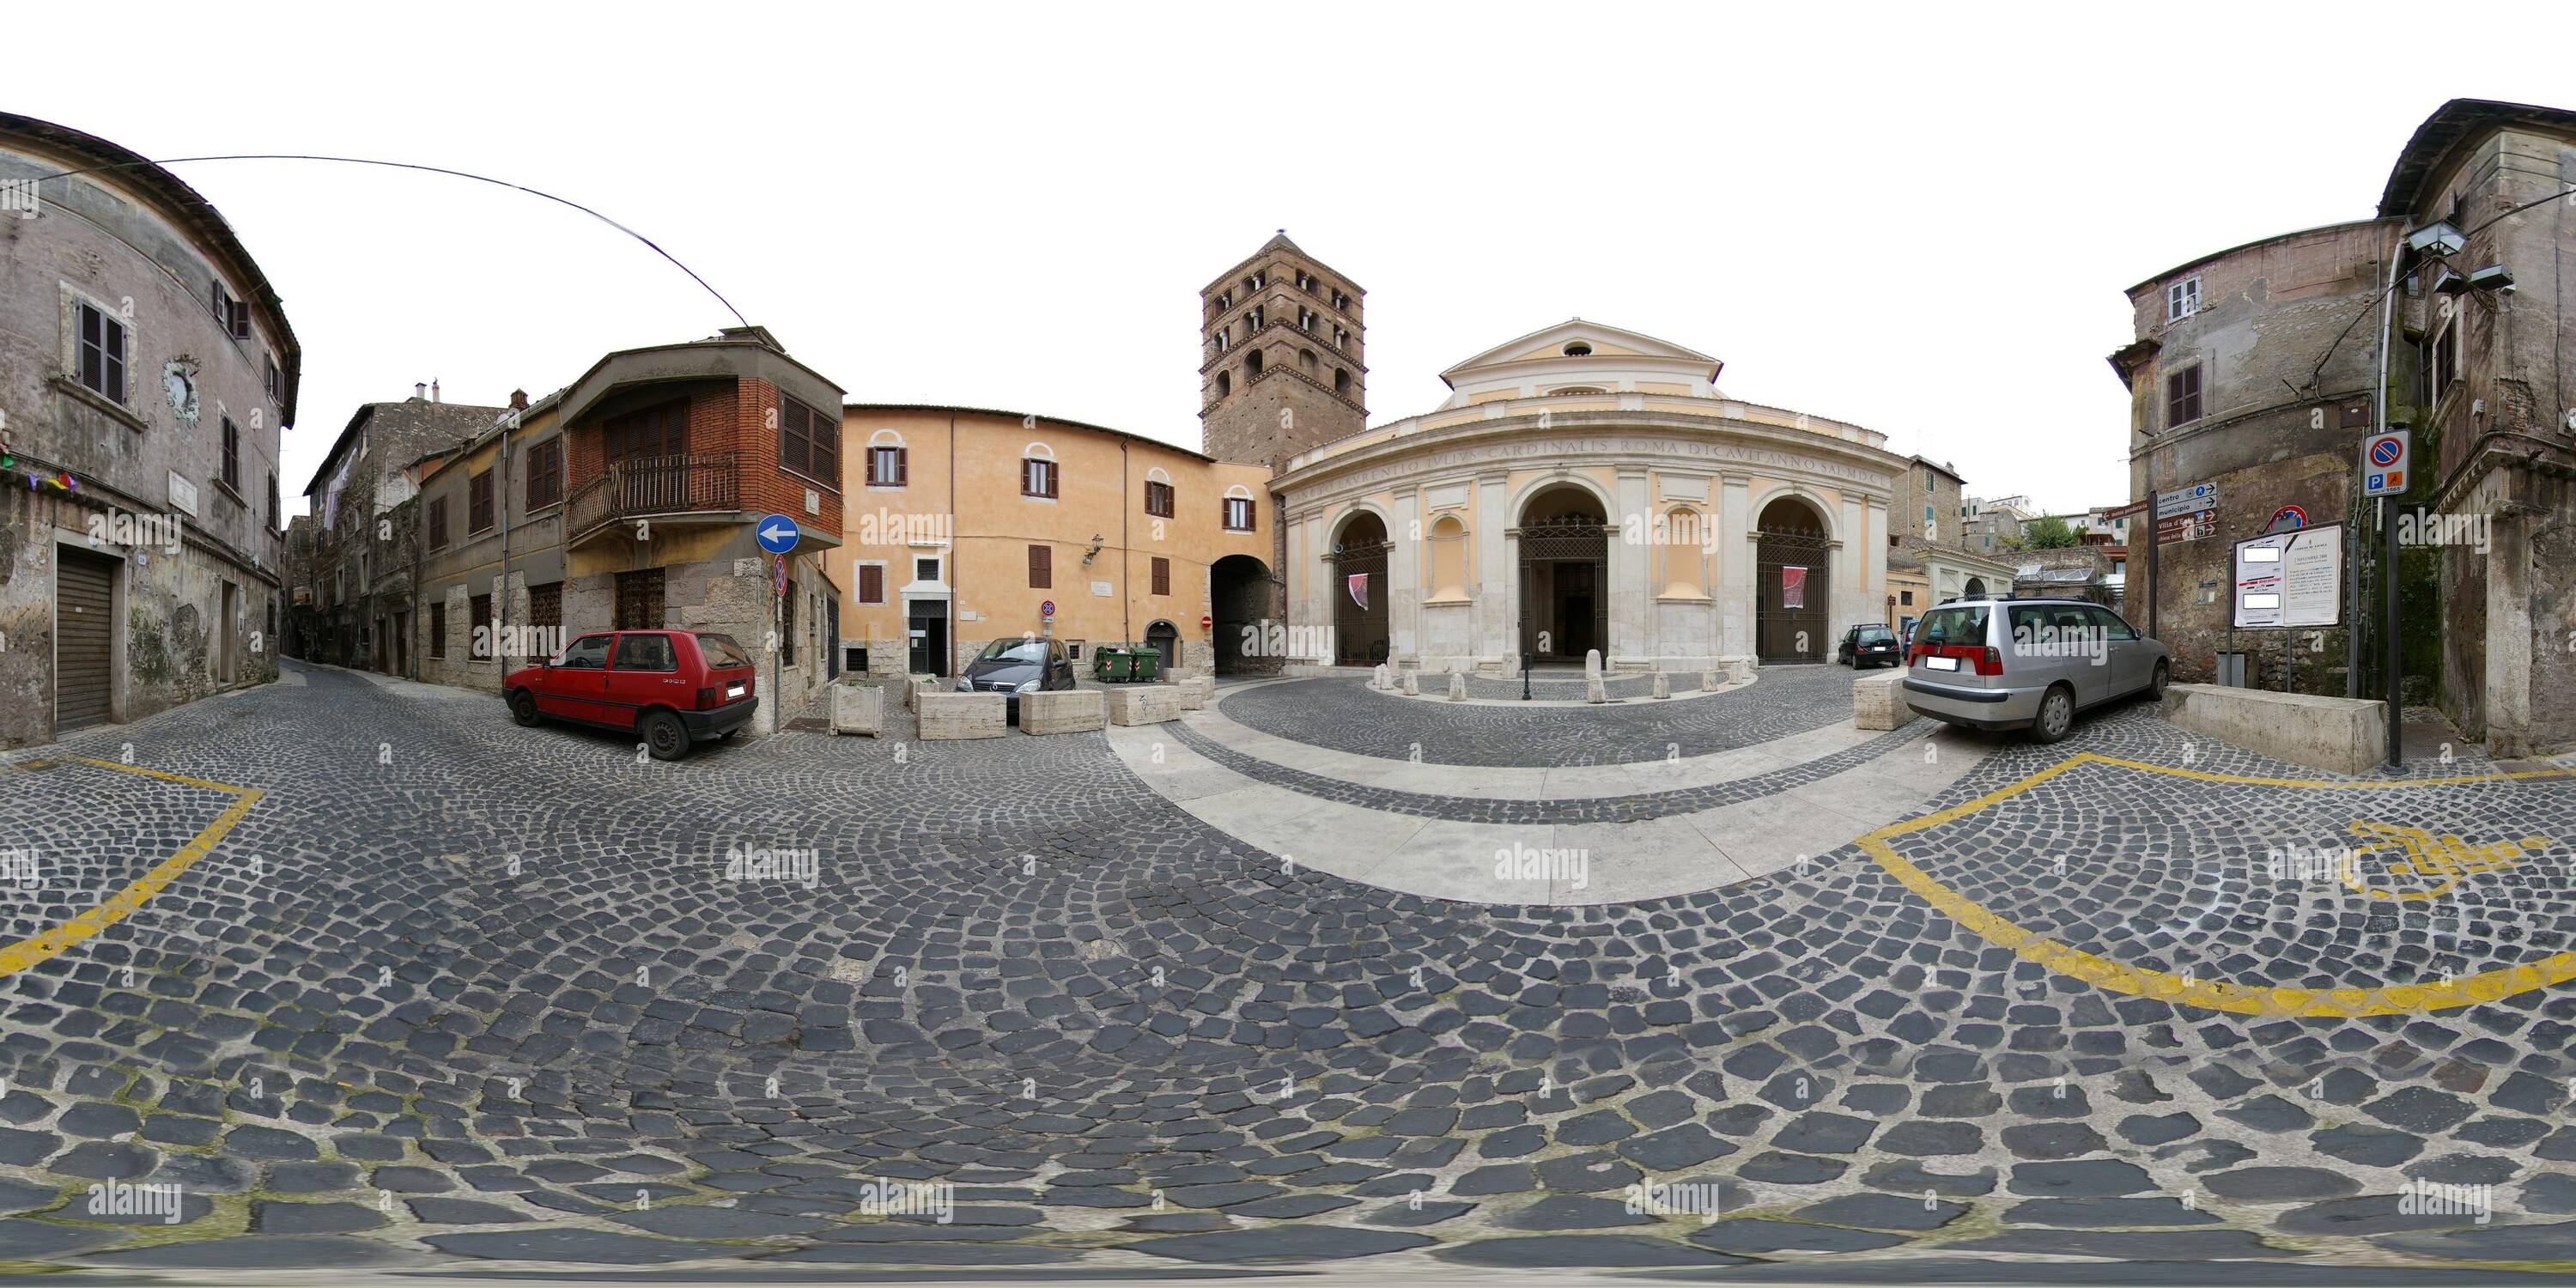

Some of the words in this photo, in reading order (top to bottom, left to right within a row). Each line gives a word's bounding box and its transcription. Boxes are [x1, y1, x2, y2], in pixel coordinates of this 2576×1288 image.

[1428, 451, 1477, 468] IVLIVS
[1487, 440, 1608, 458] CARDINALIS
[1621, 440, 1679, 454] ROMA
[1688, 443, 1761, 463] DICAVIT
[1765, 453, 1815, 469] ANNO
[2372, 477, 2381, 489] P
[2158, 495, 2179, 504] centro
[2158, 505, 2190, 517] municipio
[2158, 520, 2172, 530] Villa
